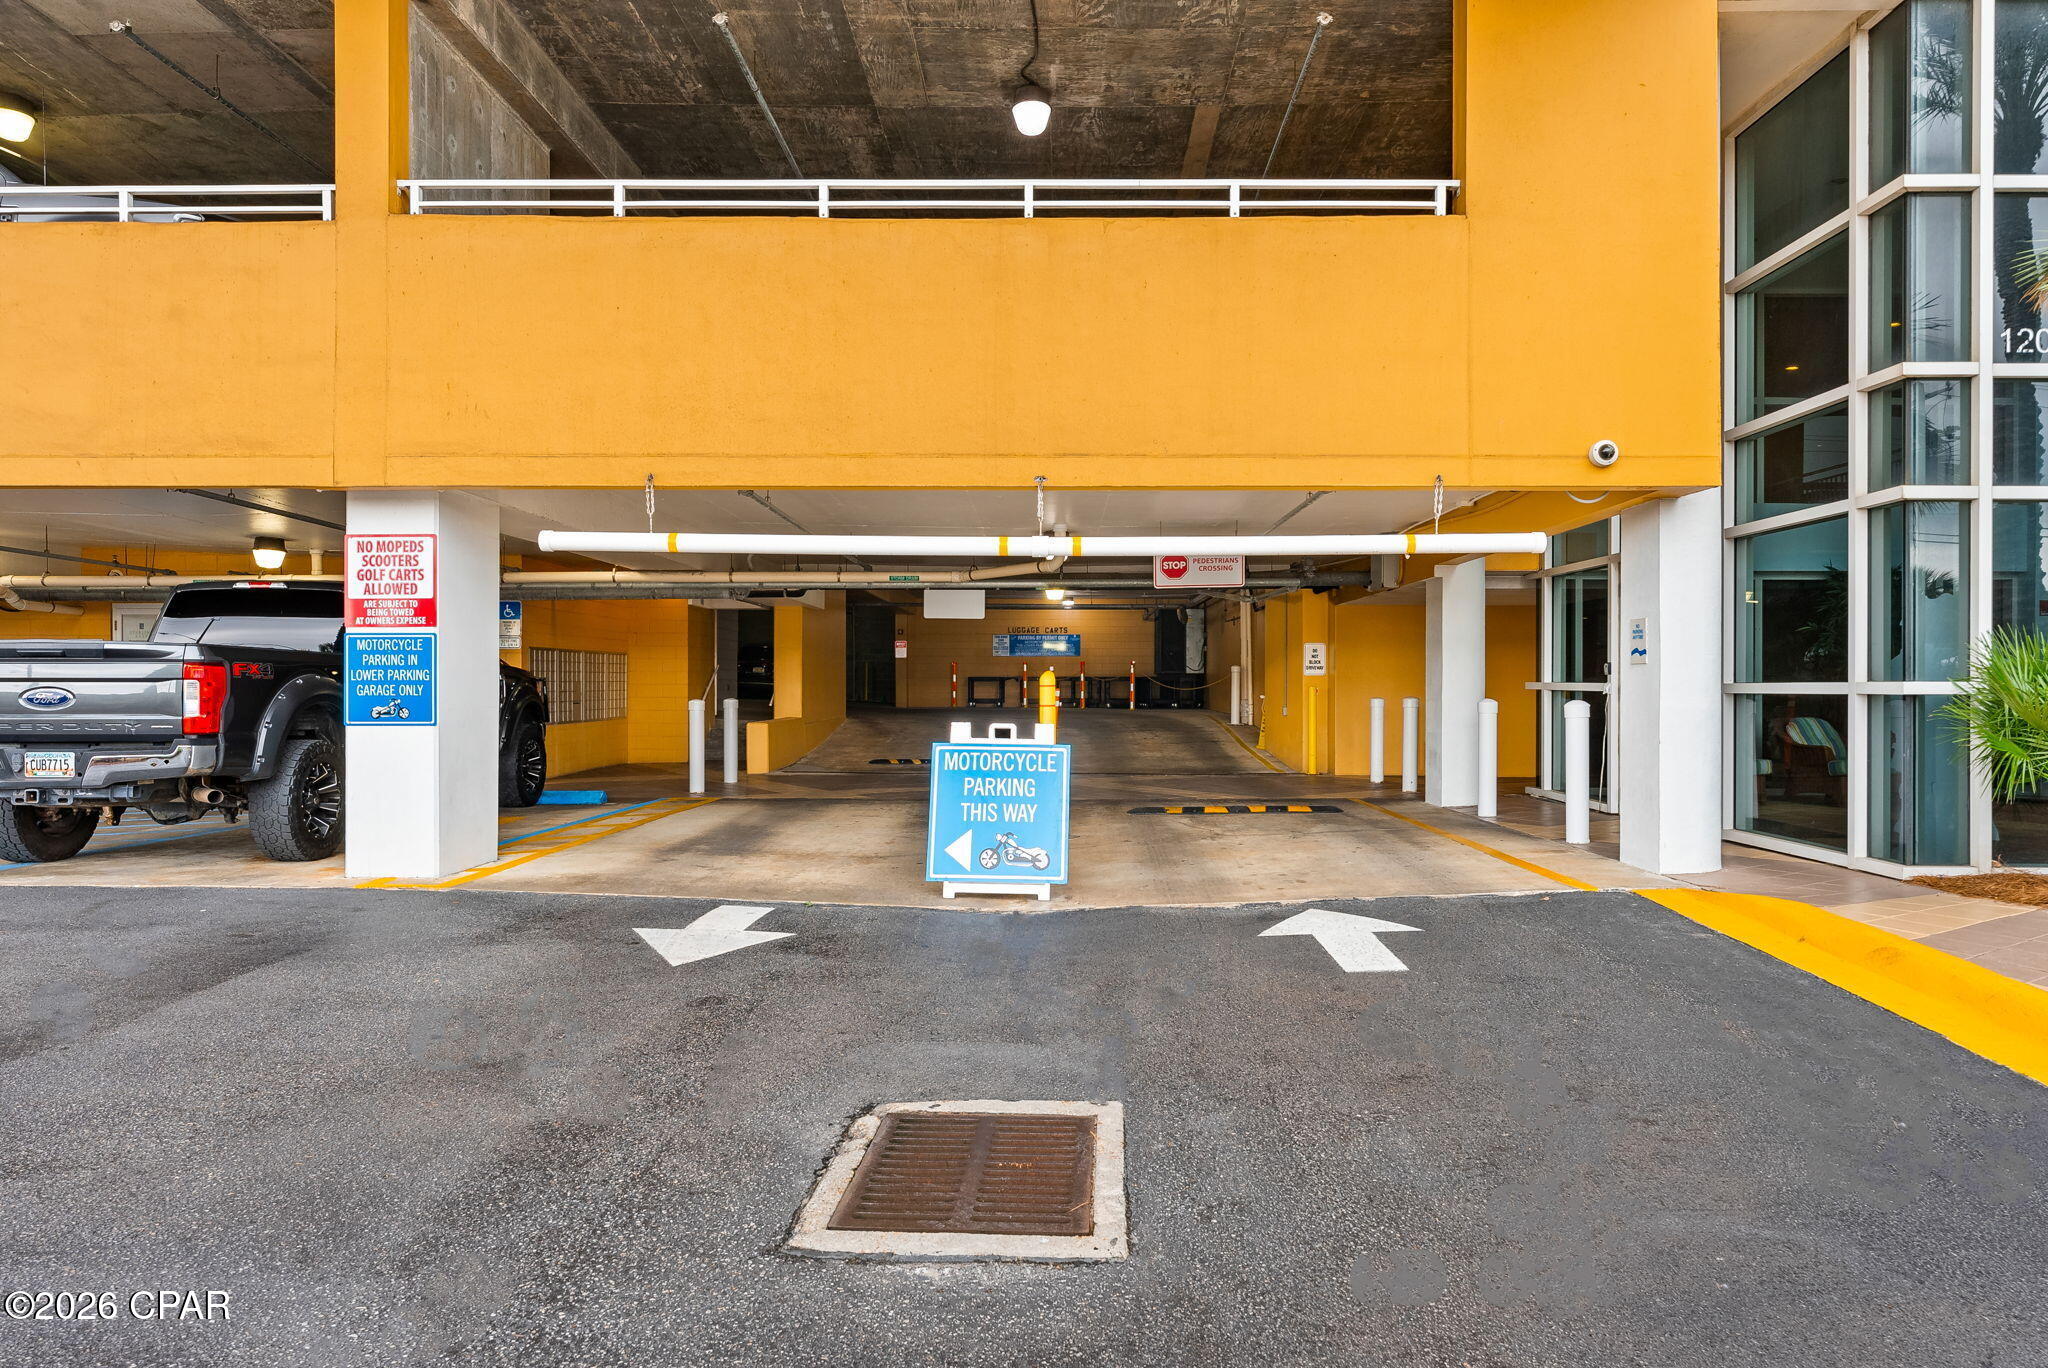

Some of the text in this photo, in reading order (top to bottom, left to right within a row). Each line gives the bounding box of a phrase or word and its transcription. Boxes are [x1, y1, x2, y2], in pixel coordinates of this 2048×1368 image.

[2000, 328, 2048, 353] 120
[356, 540, 424, 553] NO MOPEDS
[361, 554, 419, 567] SCOOTERS
[1163, 561, 1186, 570] STOP
[357, 568, 424, 581] GOLF CARTS
[363, 583, 418, 595] ALLOWED
[363, 600, 418, 608] ARE SUBJECT TO
[366, 608, 414, 616] BEING TOWED
[355, 616, 426, 625] AT OWNERS EXPENSE
[356, 639, 424, 651] MOTORCYCLE
[362, 654, 418, 666] PARKING IN
[350, 669, 430, 681] LOWER PARKING
[356, 684, 424, 696] GARAGE ONLY
[33, 692, 60, 704] Ford
[30, 758, 70, 771] CUB7715
[944, 752, 1057, 772] MOTORCYCLE
[963, 777, 1036, 797] PARKING
[960, 802, 1038, 823] THIS WAY
